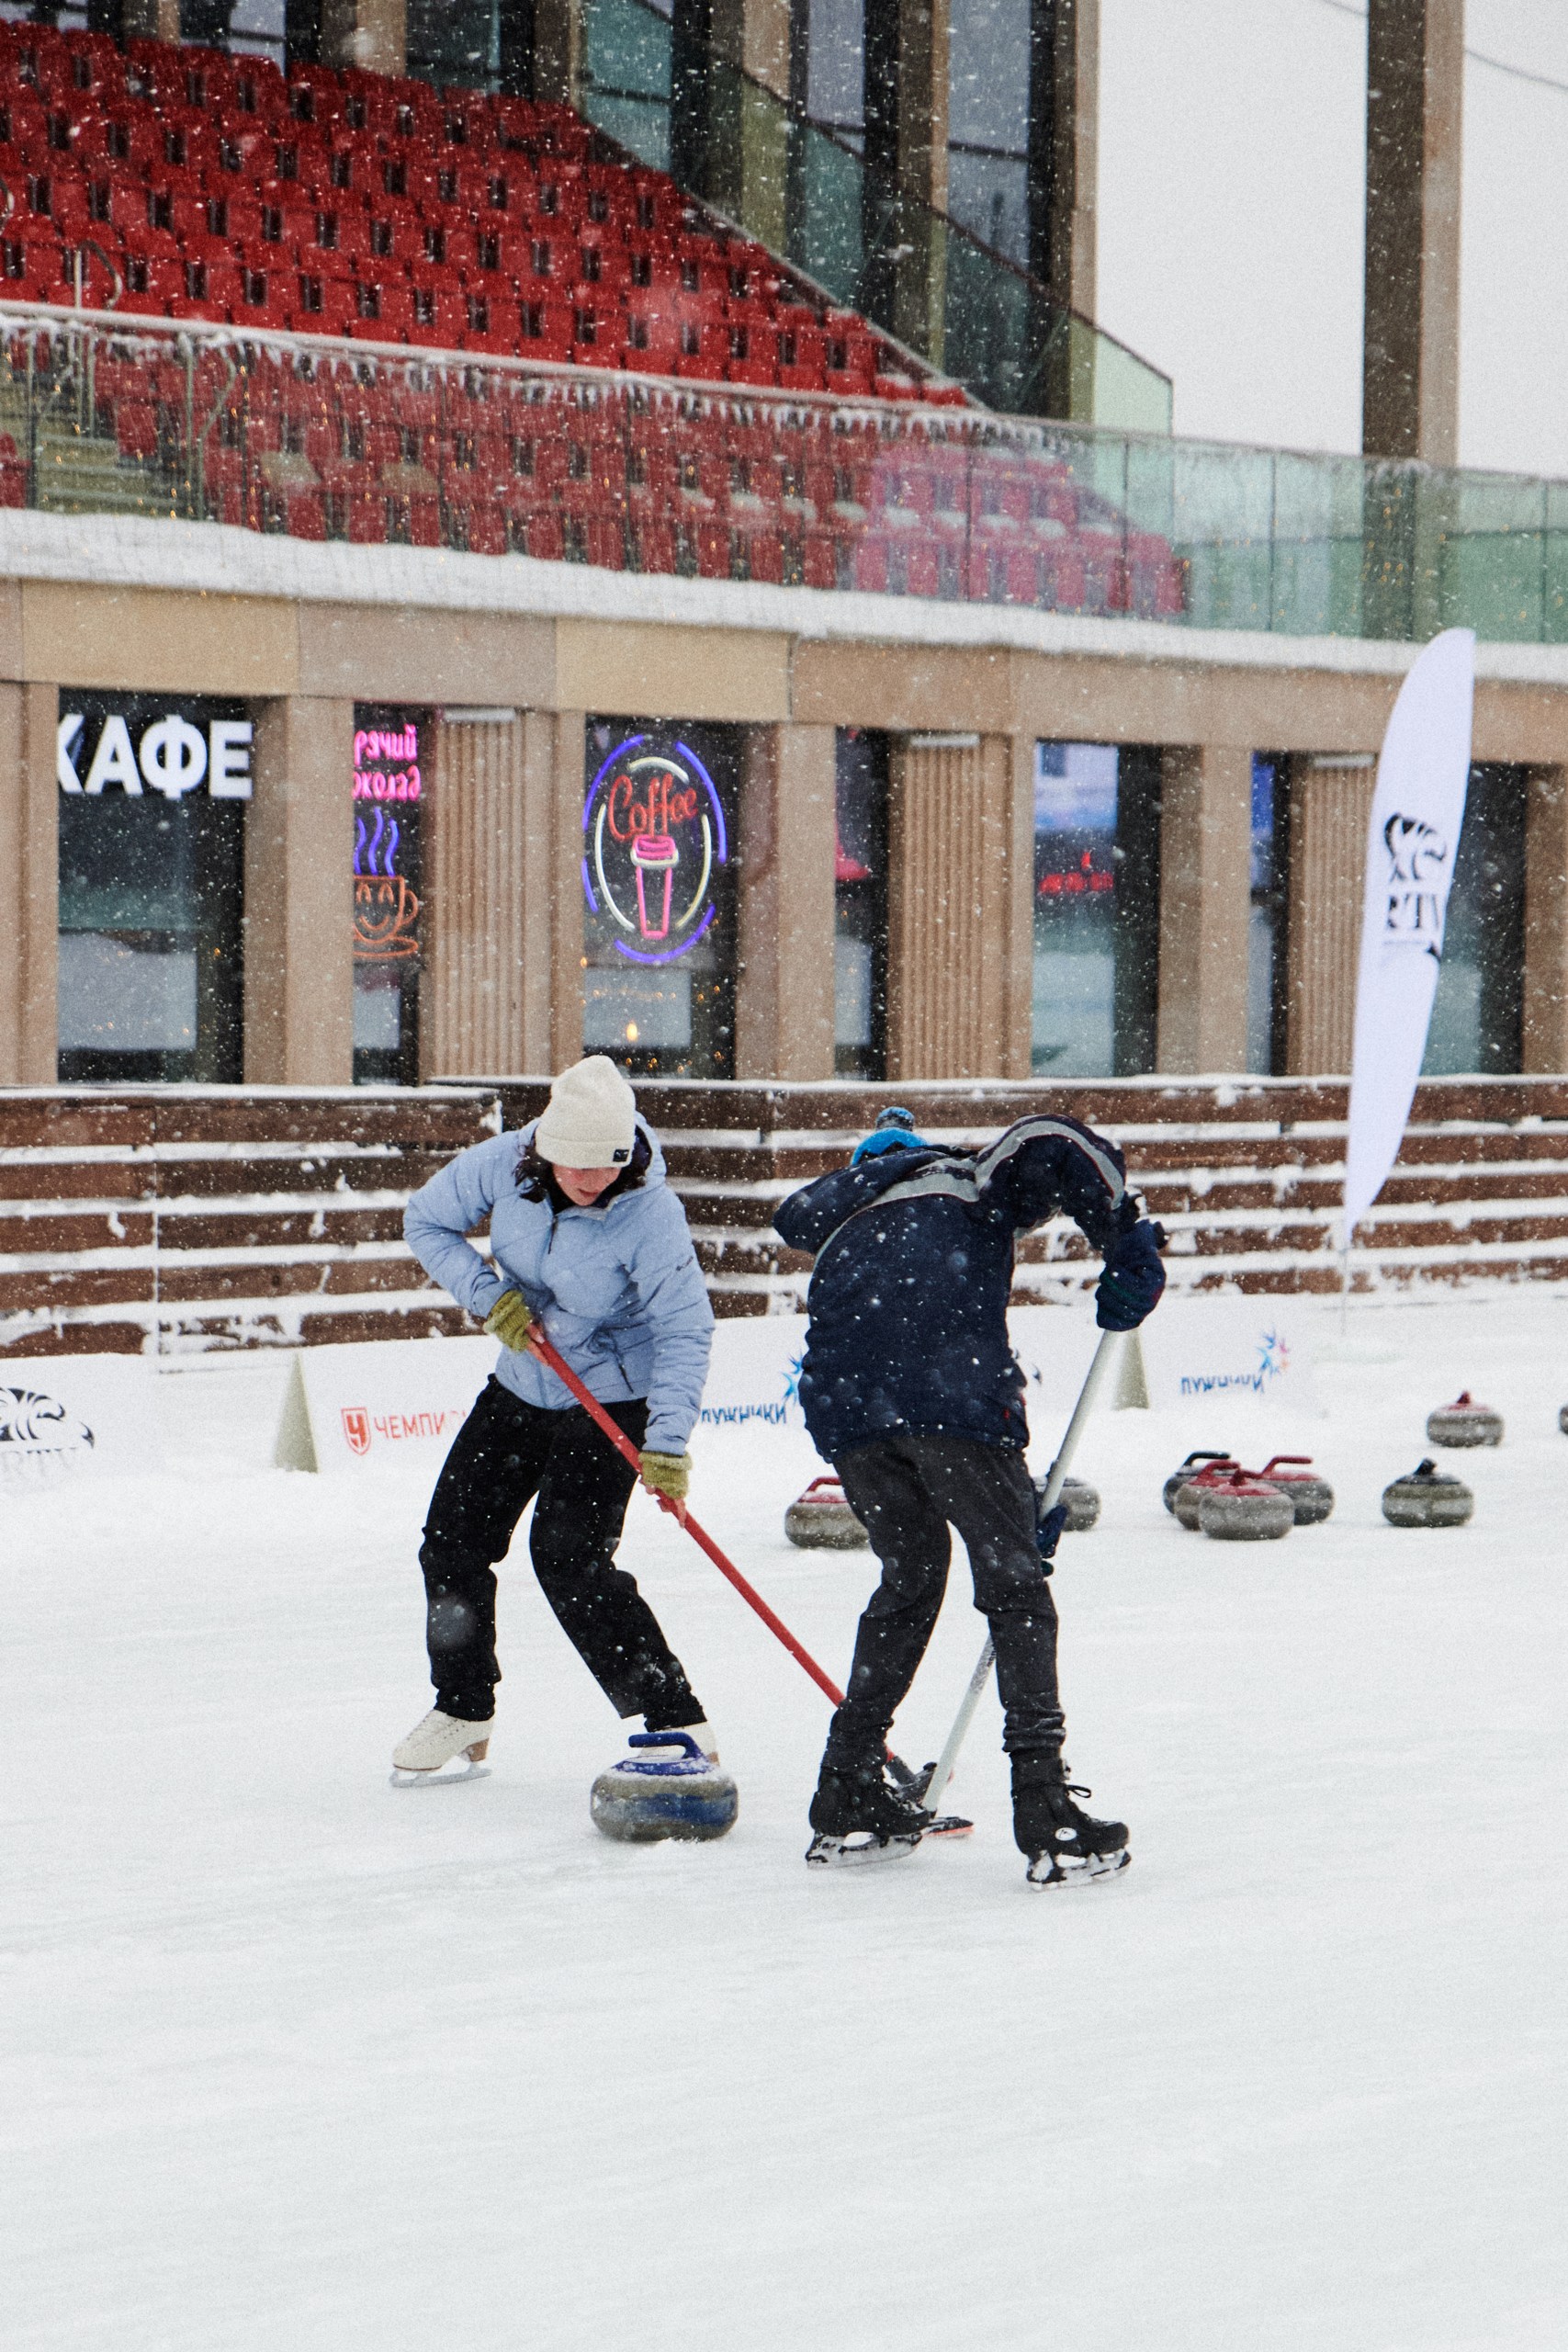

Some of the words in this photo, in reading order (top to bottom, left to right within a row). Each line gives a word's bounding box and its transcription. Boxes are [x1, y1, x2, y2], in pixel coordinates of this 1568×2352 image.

[57, 713, 253, 800] КАФЕ
[608, 773, 698, 842] Coffee
[373, 1409, 467, 1440] ЧЕМПИ
